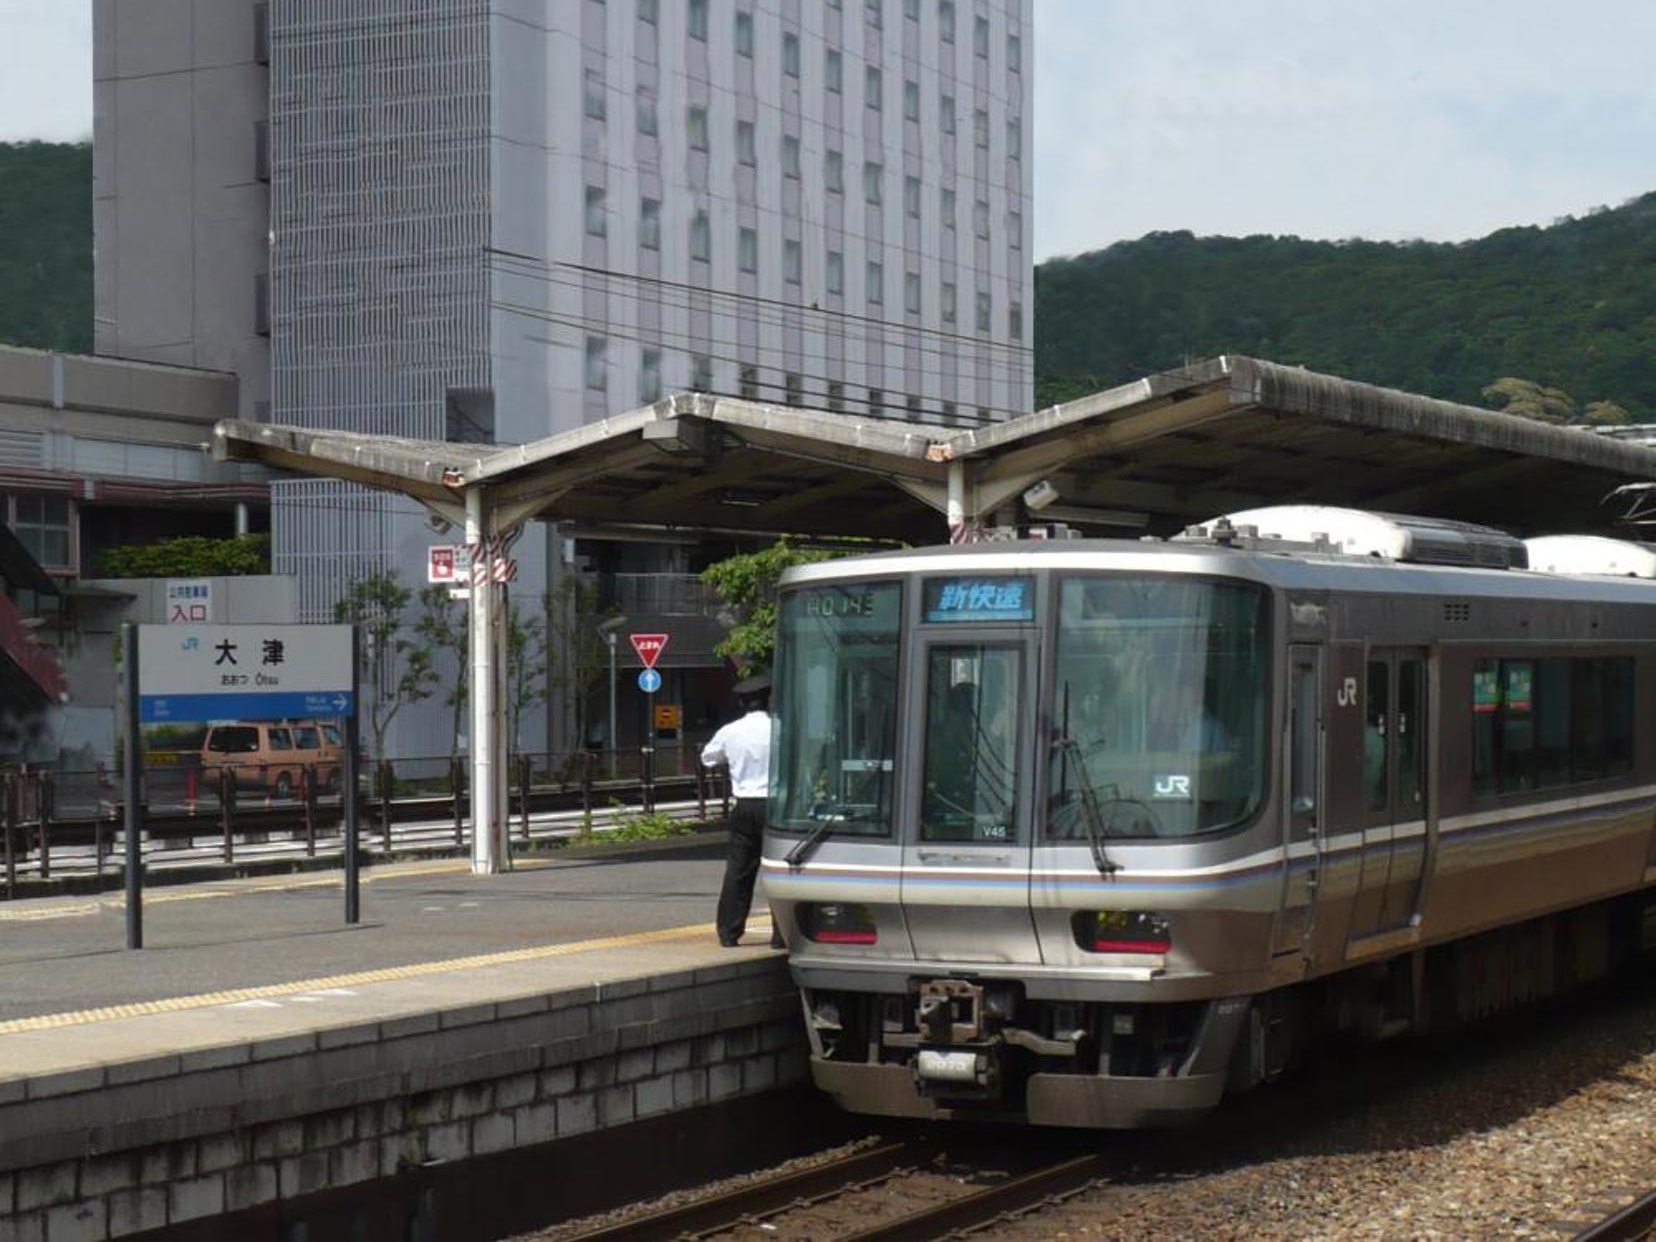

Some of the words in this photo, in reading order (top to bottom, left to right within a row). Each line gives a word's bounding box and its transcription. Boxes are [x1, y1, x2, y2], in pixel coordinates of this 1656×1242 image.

[938, 582, 1024, 609] 新快速
[172, 605, 206, 622] 入口
[181, 636, 199, 651] JR
[215, 639, 284, 666] 大津
[222, 675, 248, 686] おおつ
[1338, 678, 1356, 706] JR
[1156, 775, 1189, 793] JR
